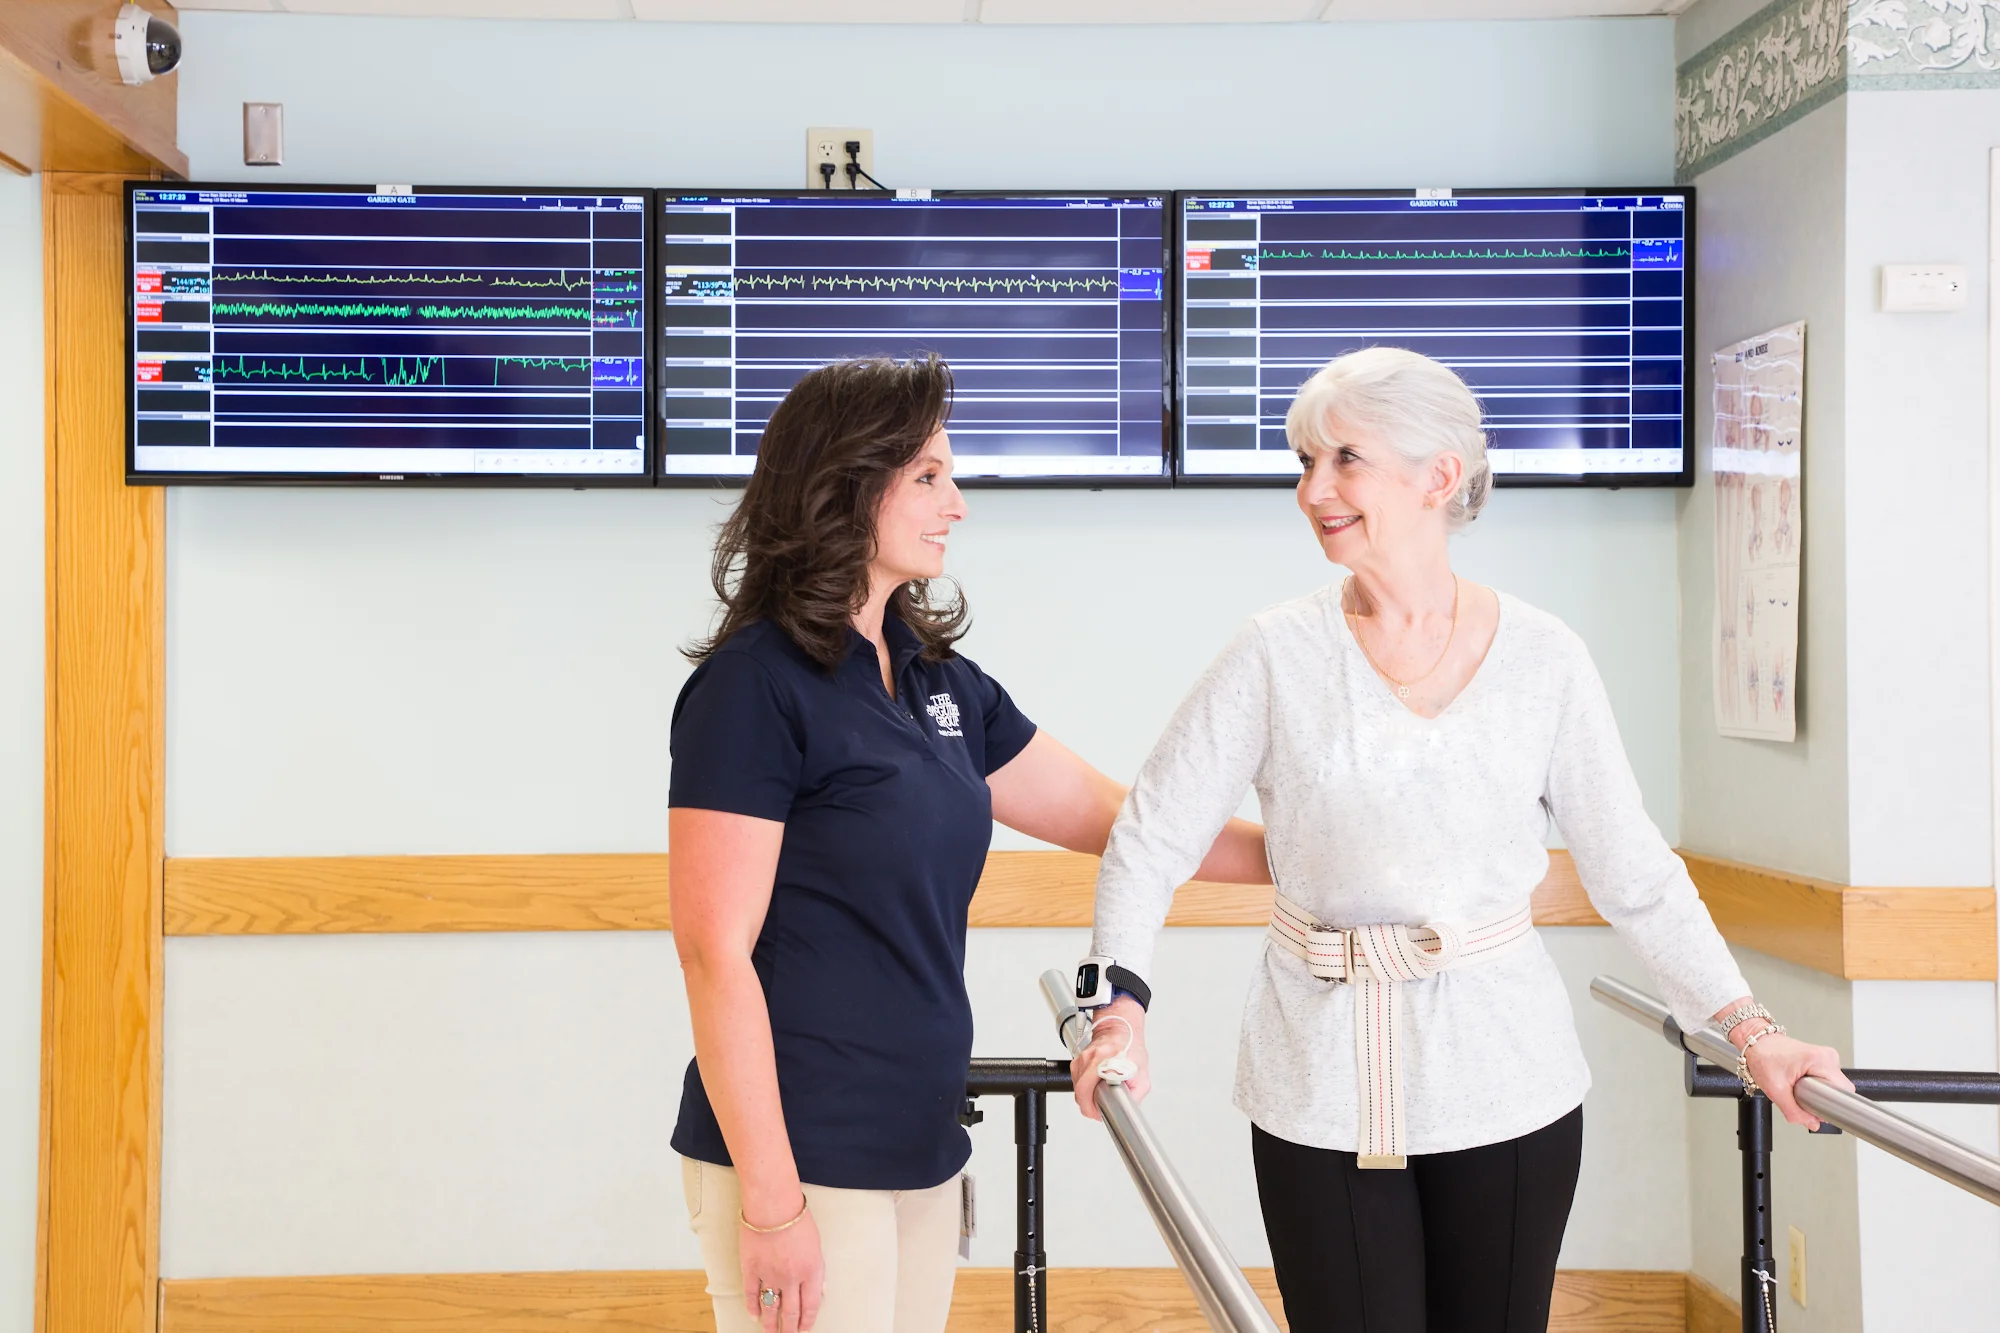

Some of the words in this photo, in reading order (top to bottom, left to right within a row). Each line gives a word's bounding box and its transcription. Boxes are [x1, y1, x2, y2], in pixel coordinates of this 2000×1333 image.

[391, 185, 398, 194] A
[911, 189, 918, 198] B
[1430, 188, 1438, 198] C
[159, 193, 186, 201] 12:27:23
[1208, 201, 1235, 209] 12:27:23
[1745, 348, 1755, 360] AND
[1755, 343, 1769, 356] KNEE
[930, 693, 952, 706] THE
[935, 715, 960, 731] GROUP
